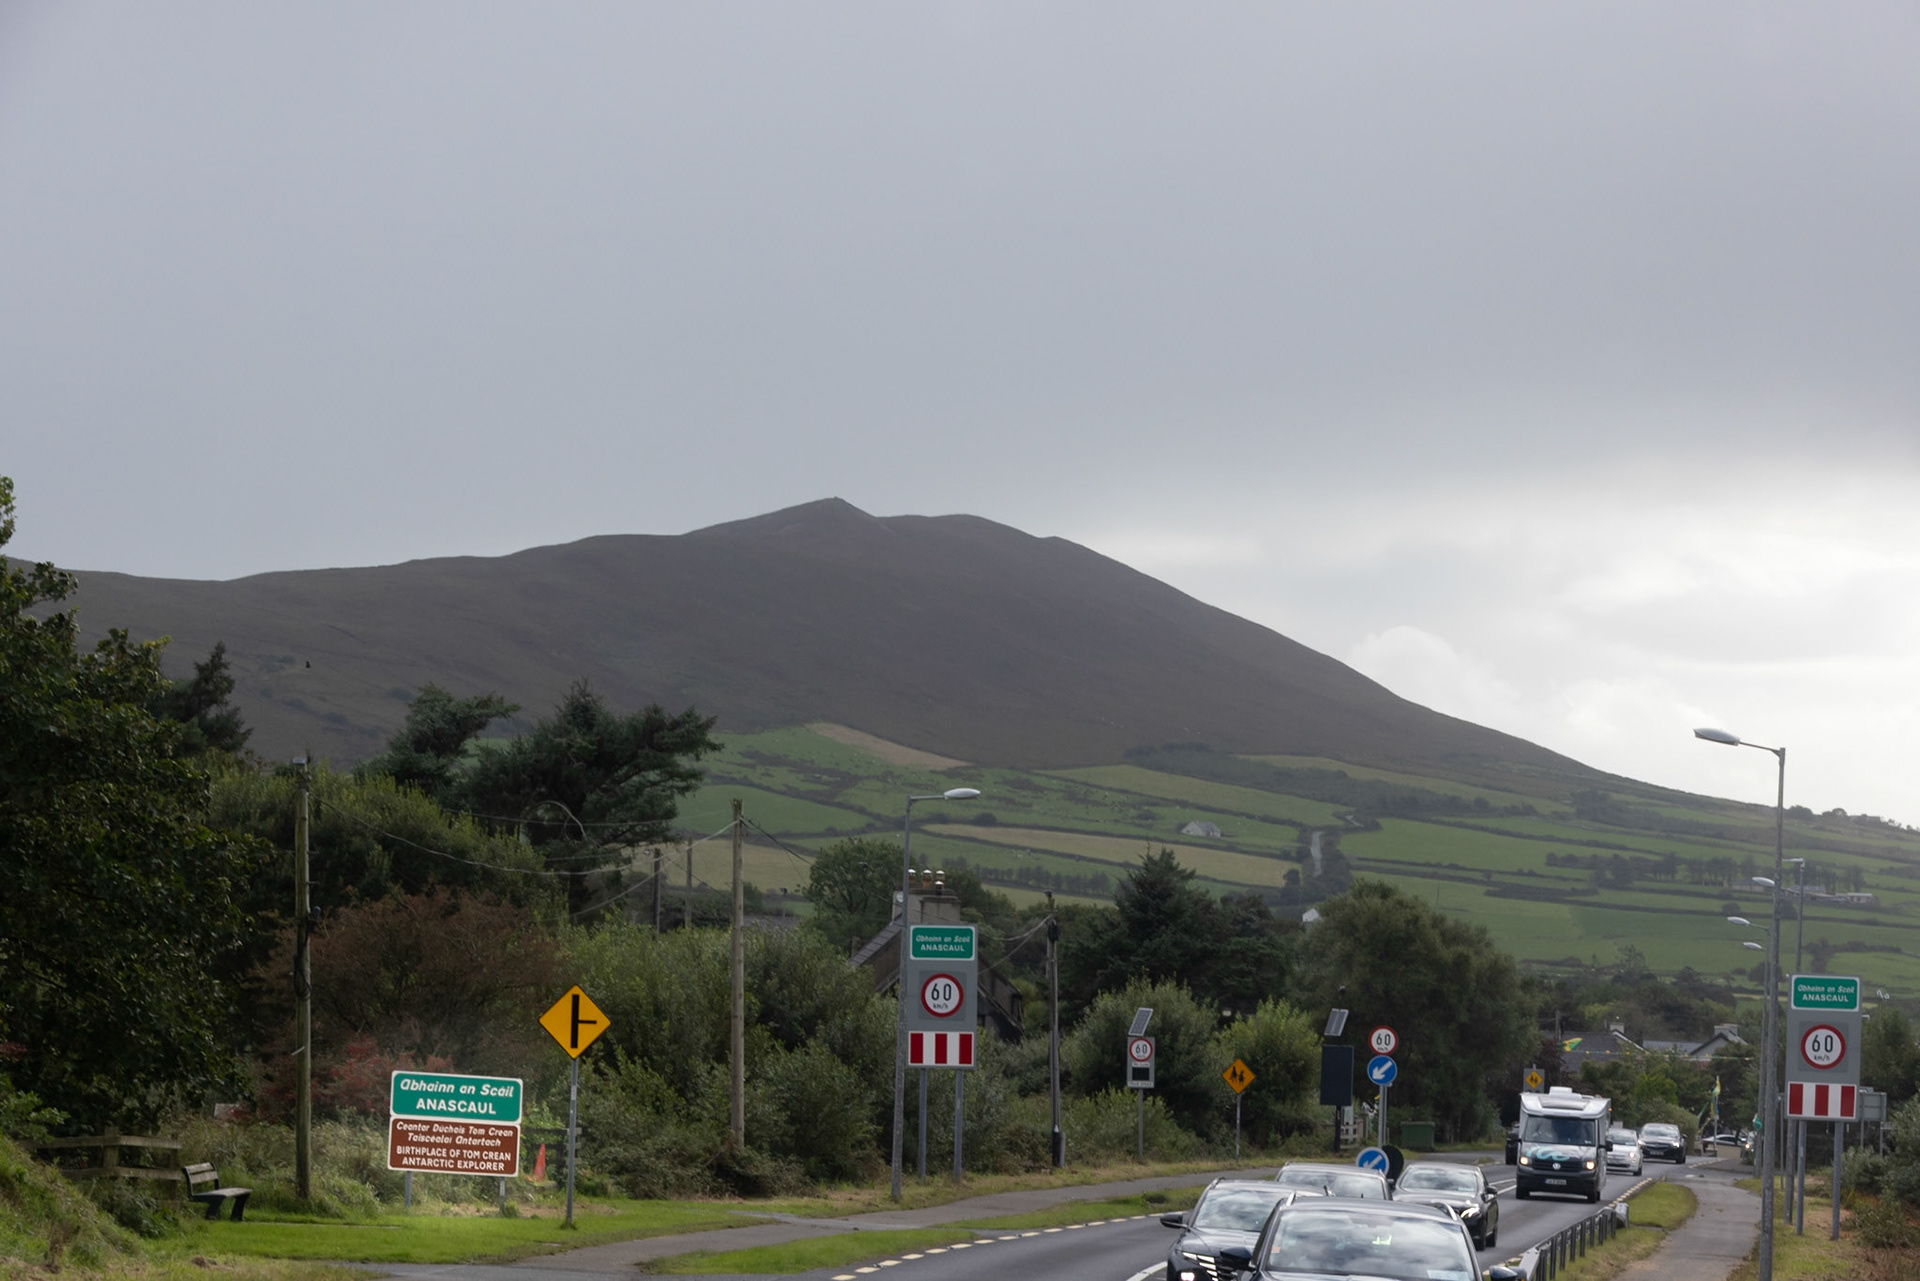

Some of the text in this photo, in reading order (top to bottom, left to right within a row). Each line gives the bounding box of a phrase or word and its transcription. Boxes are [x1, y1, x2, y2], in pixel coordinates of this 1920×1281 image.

[920, 944, 965, 952] ANASCAUL
[931, 983, 952, 1001] 60
[1802, 993, 1849, 1003] ANASCAUL
[1376, 1033, 1391, 1046] 60
[1812, 1034, 1833, 1053] 60
[1135, 1043, 1148, 1054] 60
[459, 1085, 476, 1095] an
[480, 1083, 514, 1097] Scáil
[416, 1098, 497, 1114] ANASCAUL
[396, 1121, 430, 1132] Ceantar
[469, 1126, 485, 1135] Tom
[488, 1127, 514, 1137] Crean
[396, 1145, 511, 1161] BIRTHPLACE OF TOM CREAN
[402, 1156, 505, 1171] ANTARCTIC EXPLORER
